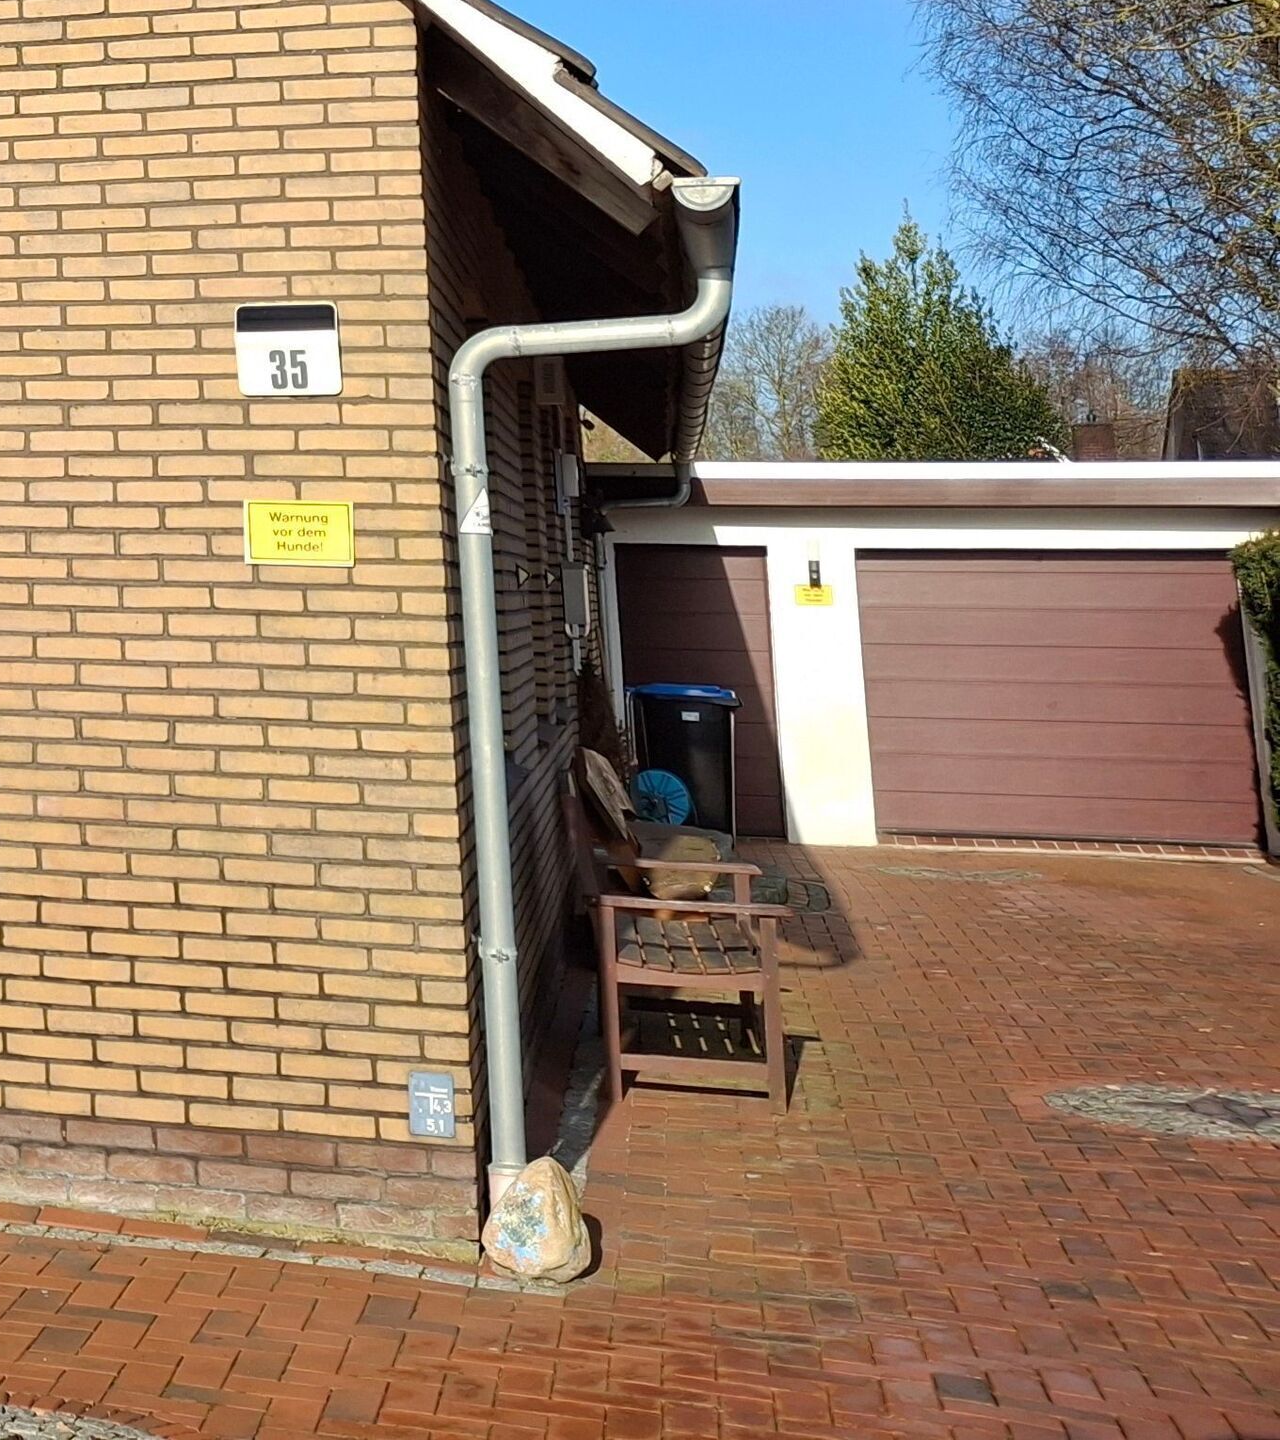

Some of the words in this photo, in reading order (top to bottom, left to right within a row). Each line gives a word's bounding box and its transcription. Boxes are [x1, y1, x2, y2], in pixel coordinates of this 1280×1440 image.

[269, 350, 308, 389] 35
[269, 511, 328, 524] Warnung
[273, 528, 293, 537] vor
[297, 527, 326, 537] dem
[277, 541, 323, 552] Hunde!
[433, 1099, 452, 1114] 4,3
[426, 1118, 444, 1134] 5,1
